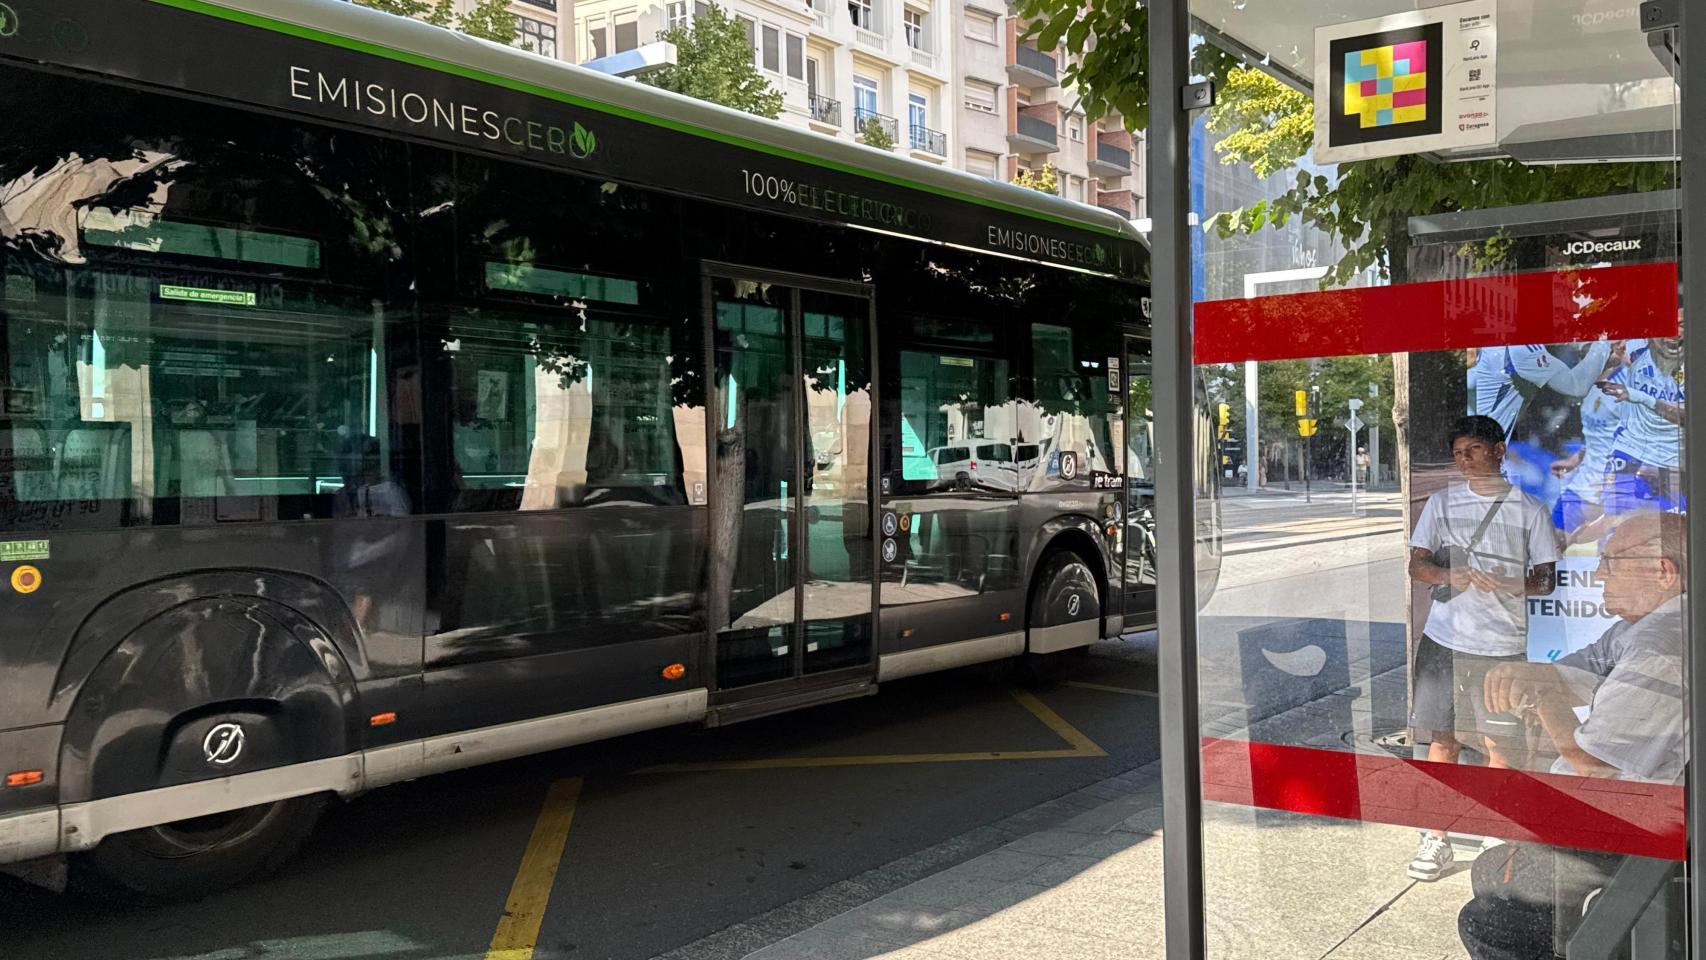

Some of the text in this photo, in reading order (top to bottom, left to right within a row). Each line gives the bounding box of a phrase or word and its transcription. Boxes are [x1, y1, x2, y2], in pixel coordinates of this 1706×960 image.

[1562, 239, 1642, 256] JCDecaux
[163, 287, 243, 302] Salida de emergencia
